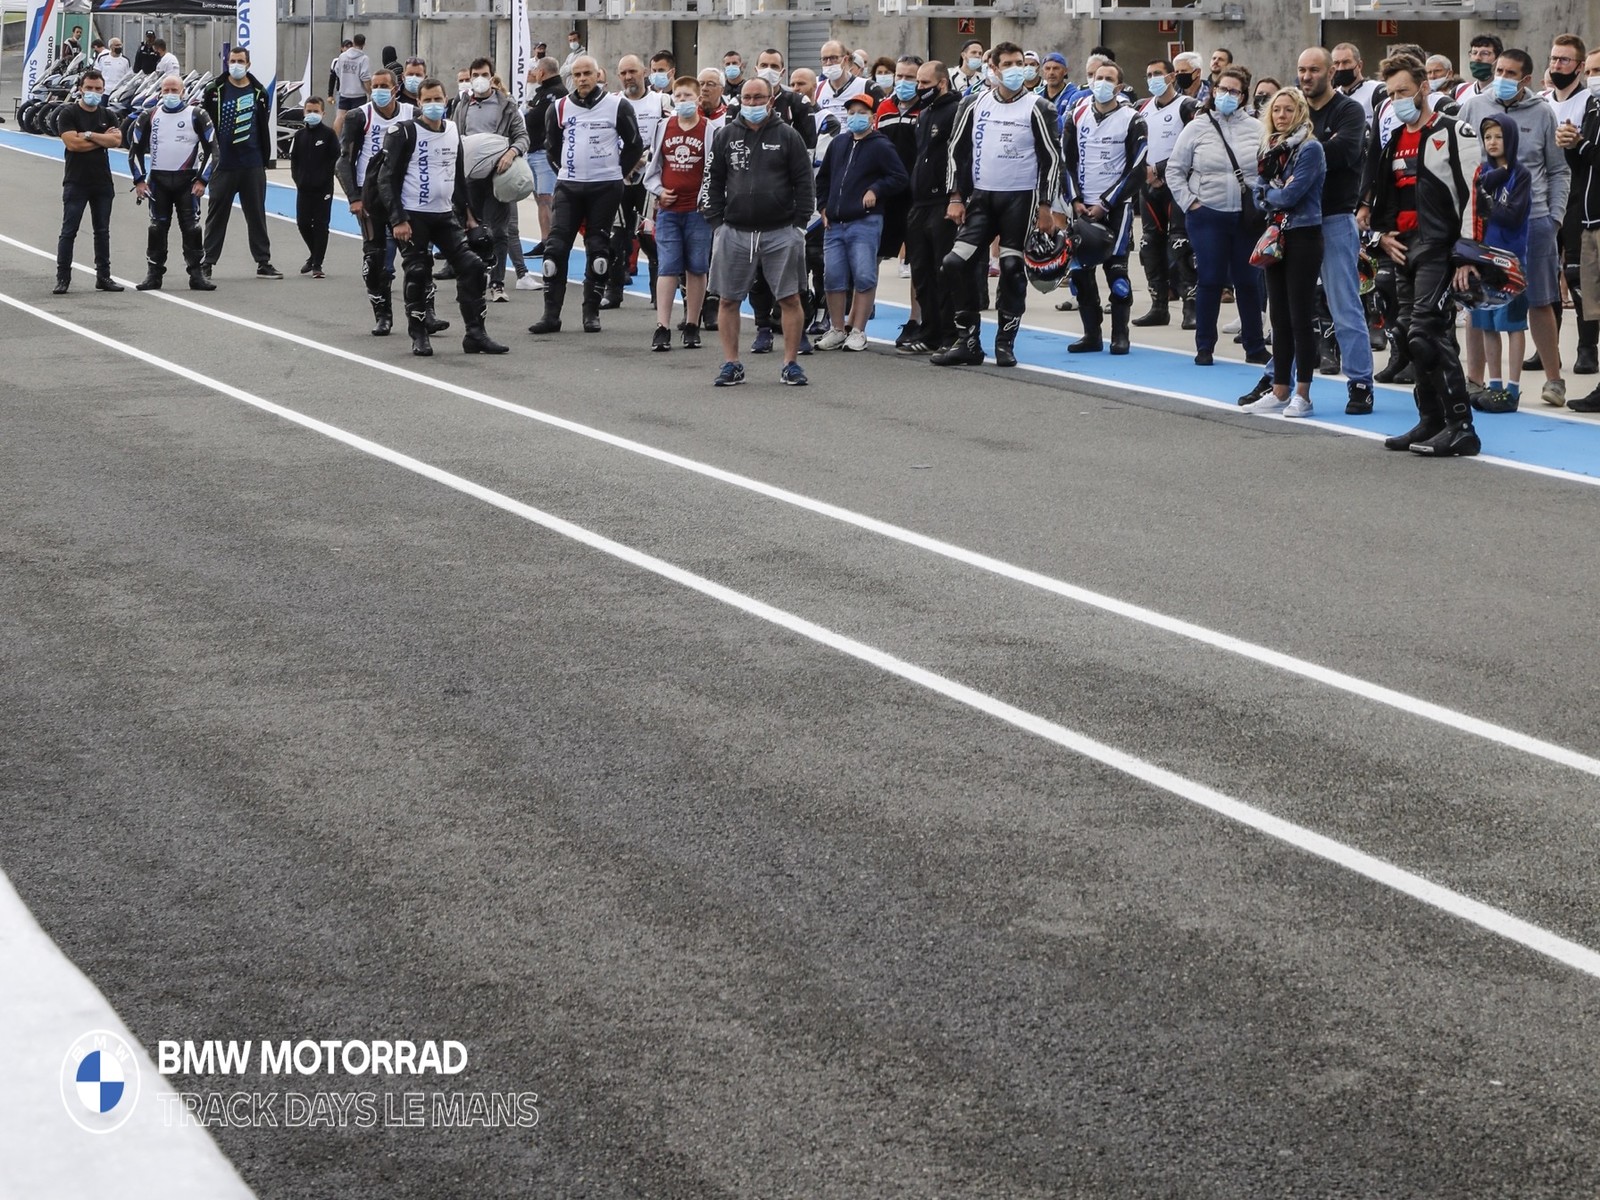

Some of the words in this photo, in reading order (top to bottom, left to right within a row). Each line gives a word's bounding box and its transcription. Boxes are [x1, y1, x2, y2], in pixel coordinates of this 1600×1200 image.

[151, 117, 160, 167] TRACKDAYS
[418, 140, 430, 205] TRACKDAYS
[566, 116, 577, 179] TRACKDAYS
[974, 110, 991, 182] TRACKDAYS
